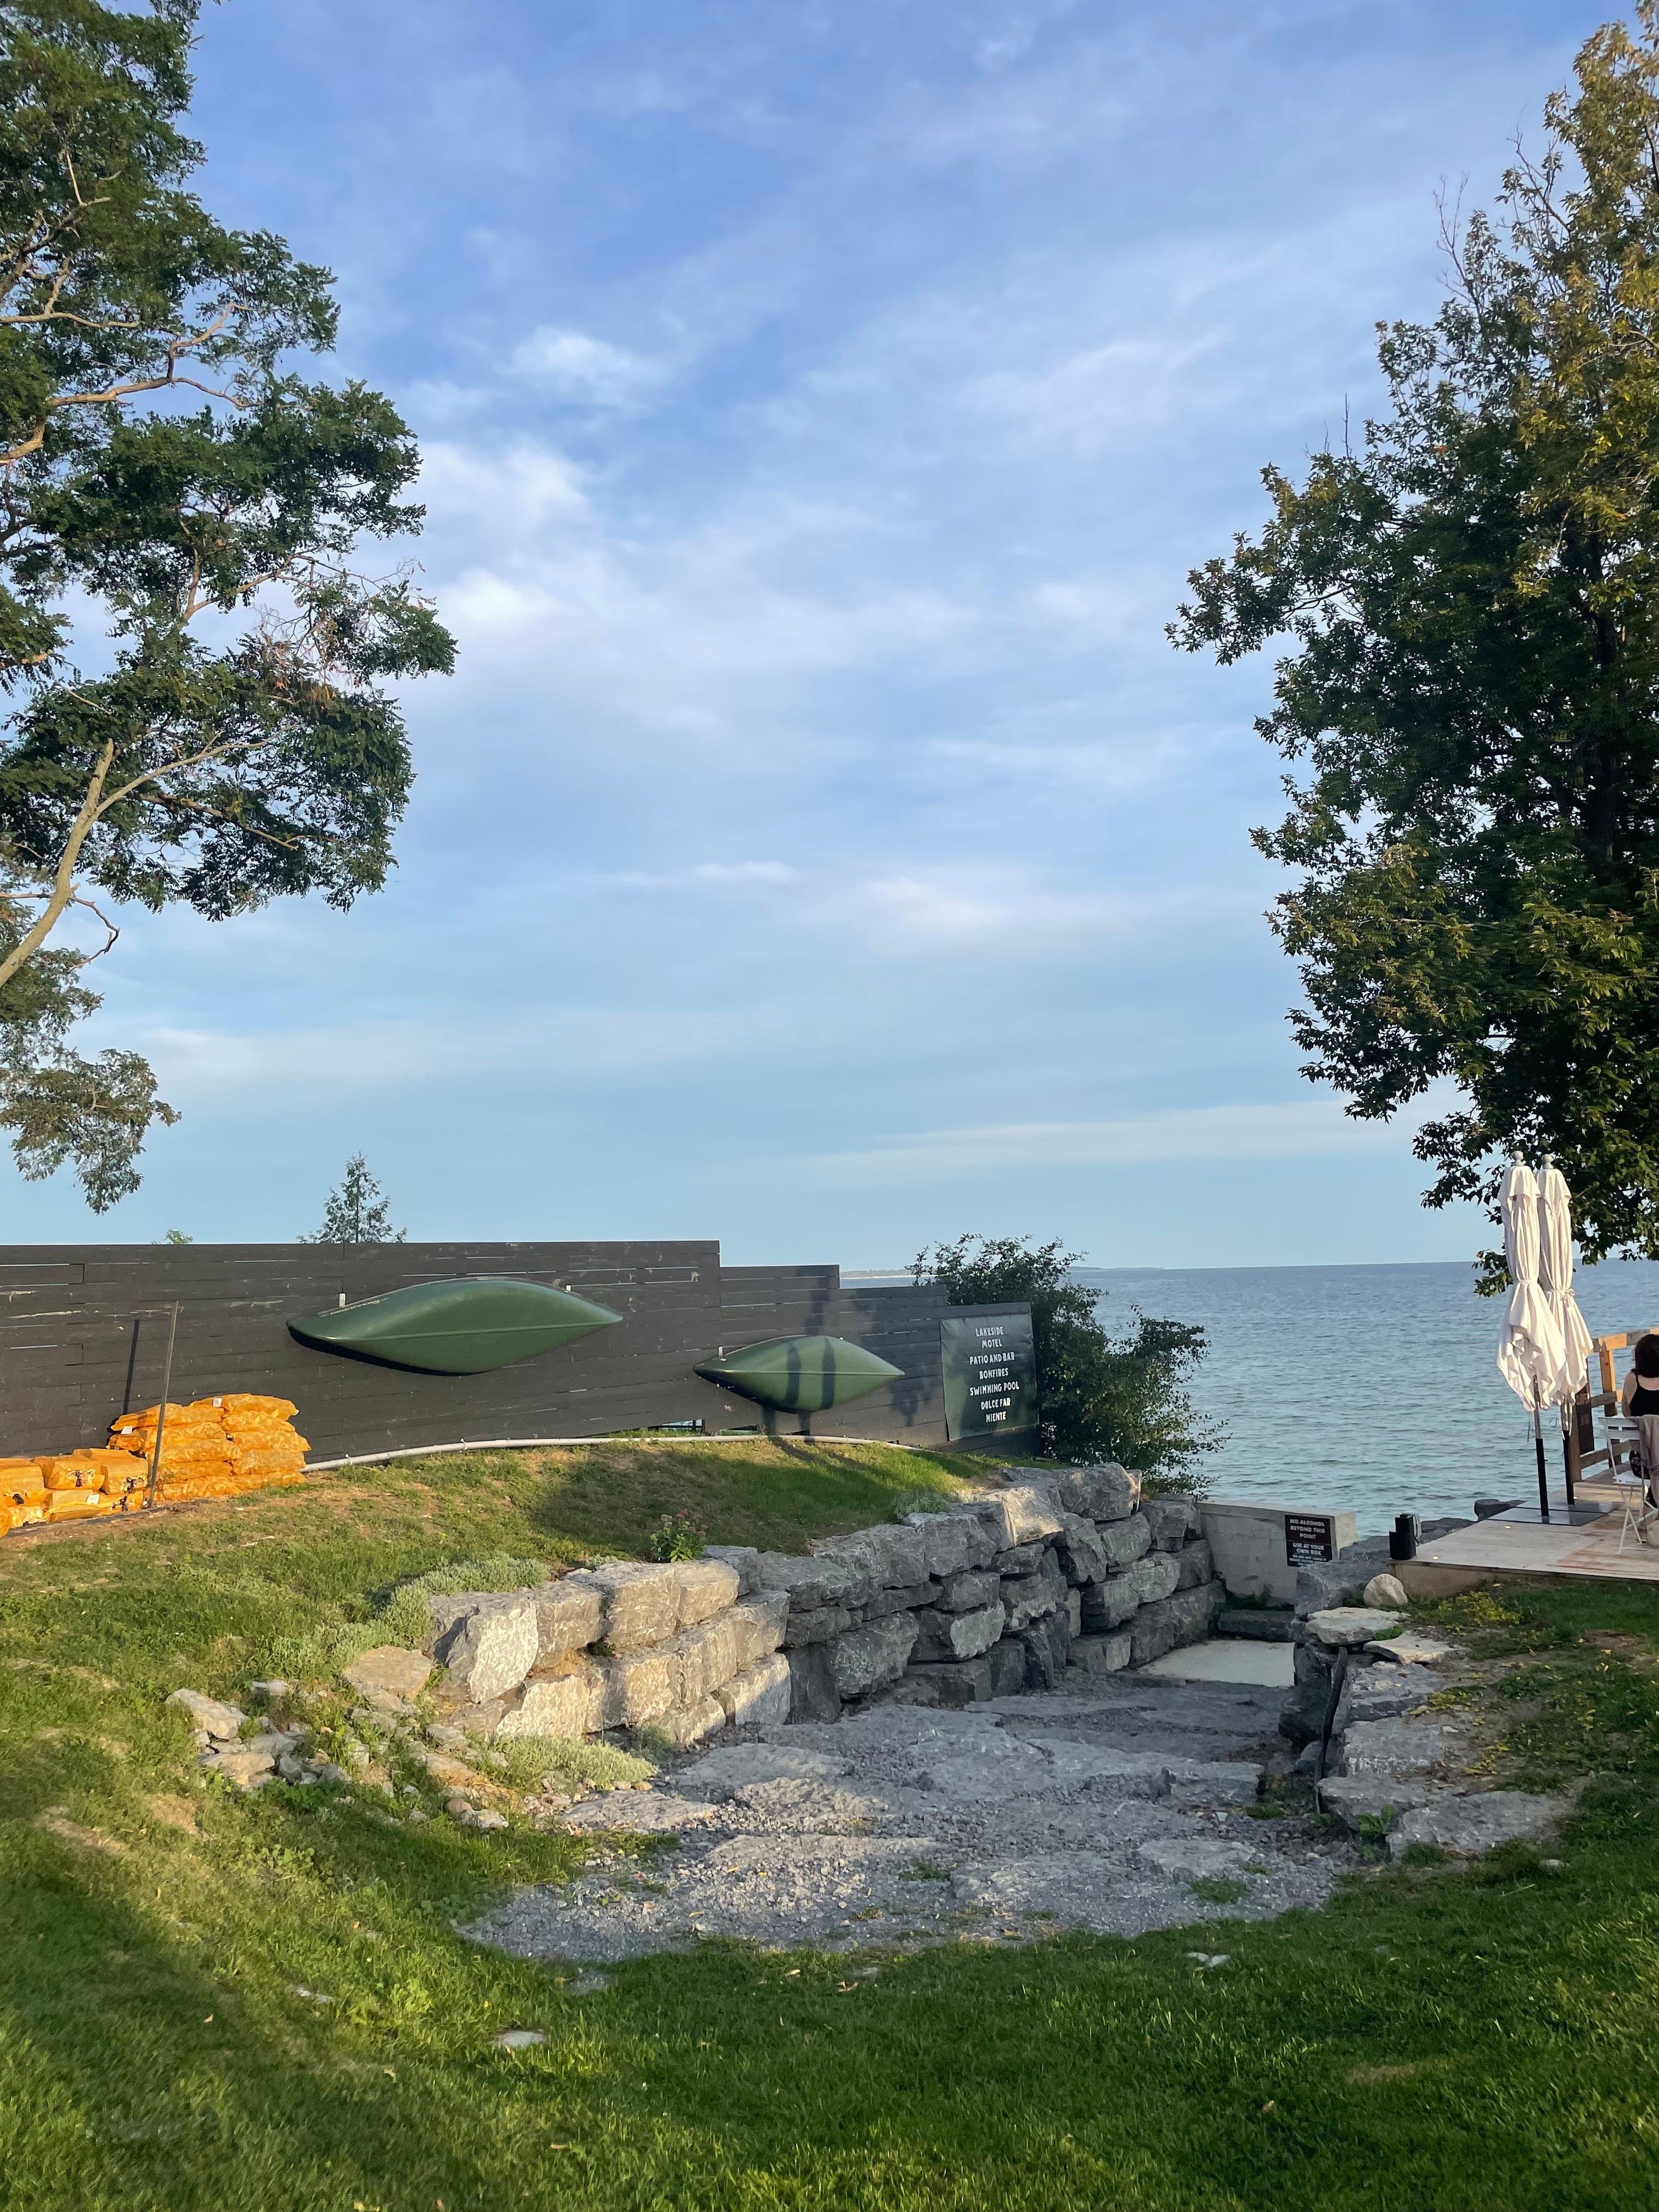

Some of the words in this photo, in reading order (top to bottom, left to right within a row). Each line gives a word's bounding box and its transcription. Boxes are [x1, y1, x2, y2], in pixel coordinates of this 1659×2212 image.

[975, 1326, 1004, 1337] LAKESIDE
[982, 1339, 1002, 1348] MOTEL
[969, 1355, 988, 1365] PATIO
[989, 1353, 1002, 1363] AND
[1003, 1352, 1015, 1362] BAR
[979, 1368, 1009, 1380] BONFIRES
[970, 1383, 1002, 1396] SWIMMING
[1003, 1381, 1019, 1392] POOL
[981, 1399, 998, 1410] DOLCE
[1000, 1397, 1011, 1407] FAR
[986, 1411, 1006, 1423] NIENTE
